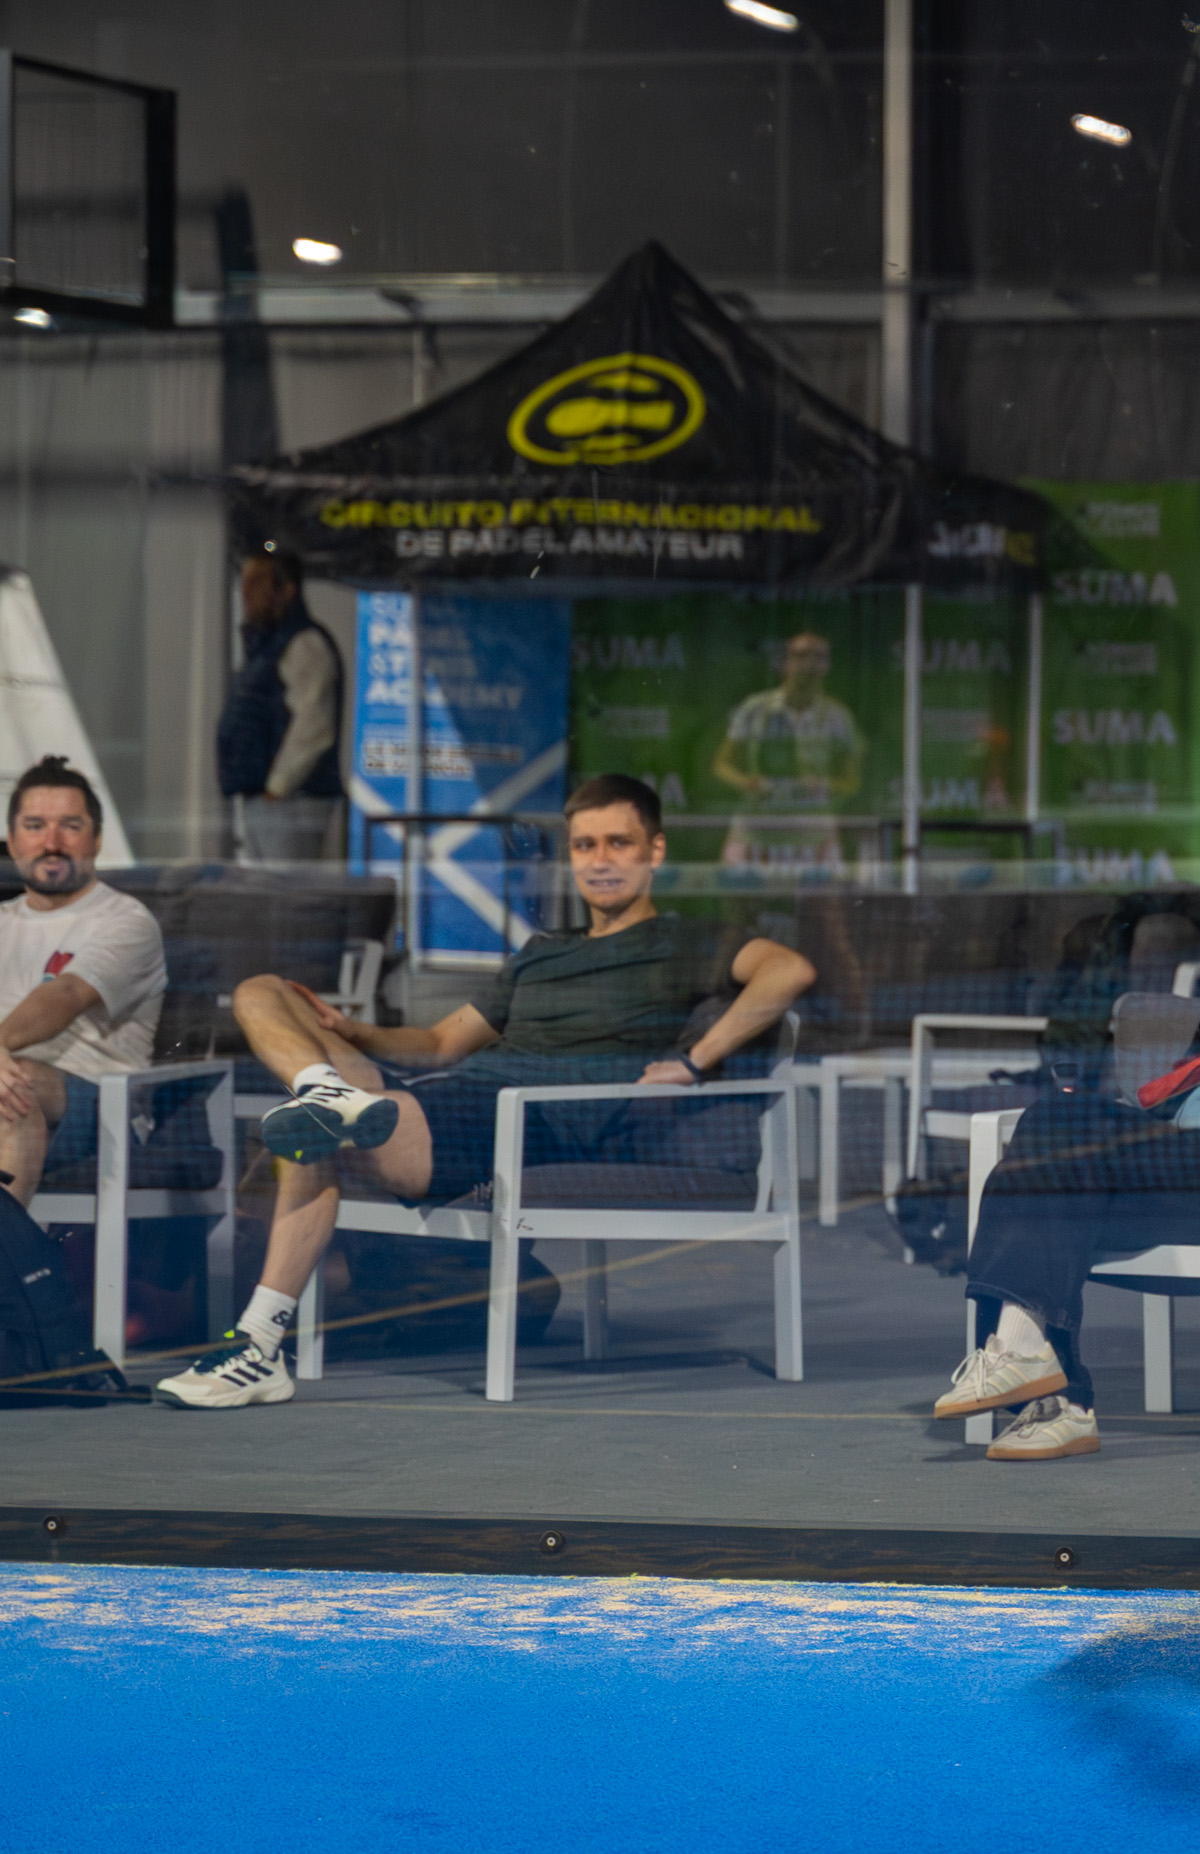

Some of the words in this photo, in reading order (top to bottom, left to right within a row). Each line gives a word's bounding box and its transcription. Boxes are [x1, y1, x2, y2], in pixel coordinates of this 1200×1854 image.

[320, 497, 504, 530] CIRCUITO
[396, 530, 441, 558] DE
[569, 529, 743, 560] AMATEUR
[1053, 569, 1179, 607] SUMA
[1053, 709, 1178, 746] SUMA
